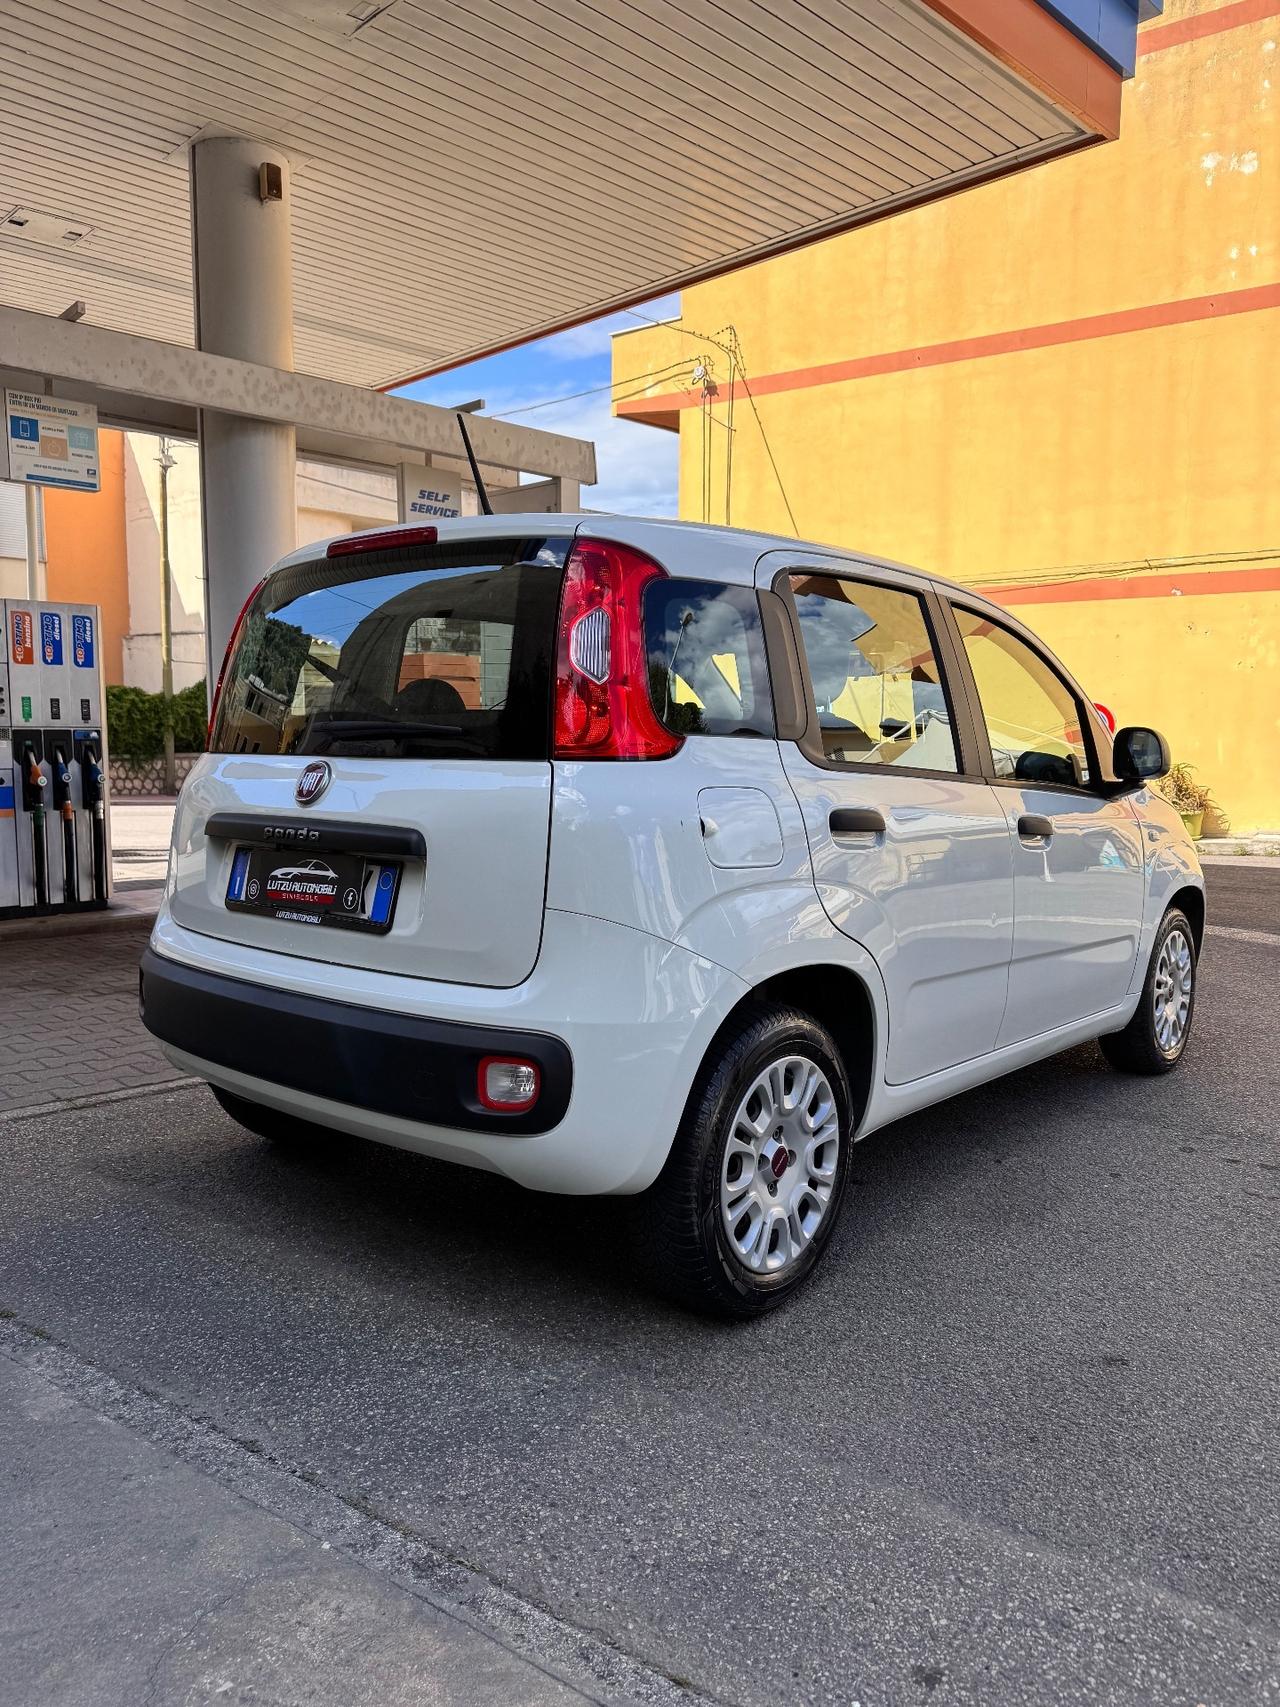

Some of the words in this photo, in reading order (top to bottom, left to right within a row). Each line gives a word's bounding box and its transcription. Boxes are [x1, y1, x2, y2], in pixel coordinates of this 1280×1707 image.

[418, 489, 451, 503] SELF
[410, 501, 459, 518] SERVICE
[15, 614, 24, 653] OPTIMO
[24, 615, 32, 648] benzina
[43, 615, 53, 654] OPTIMO
[53, 616, 61, 640] diesel
[75, 617, 84, 656] OPTIMO
[84, 618, 92, 643] diesel
[300, 772, 323, 791] FIAT
[264, 827, 320, 840] panda
[267, 880, 292, 892] LUTZU
